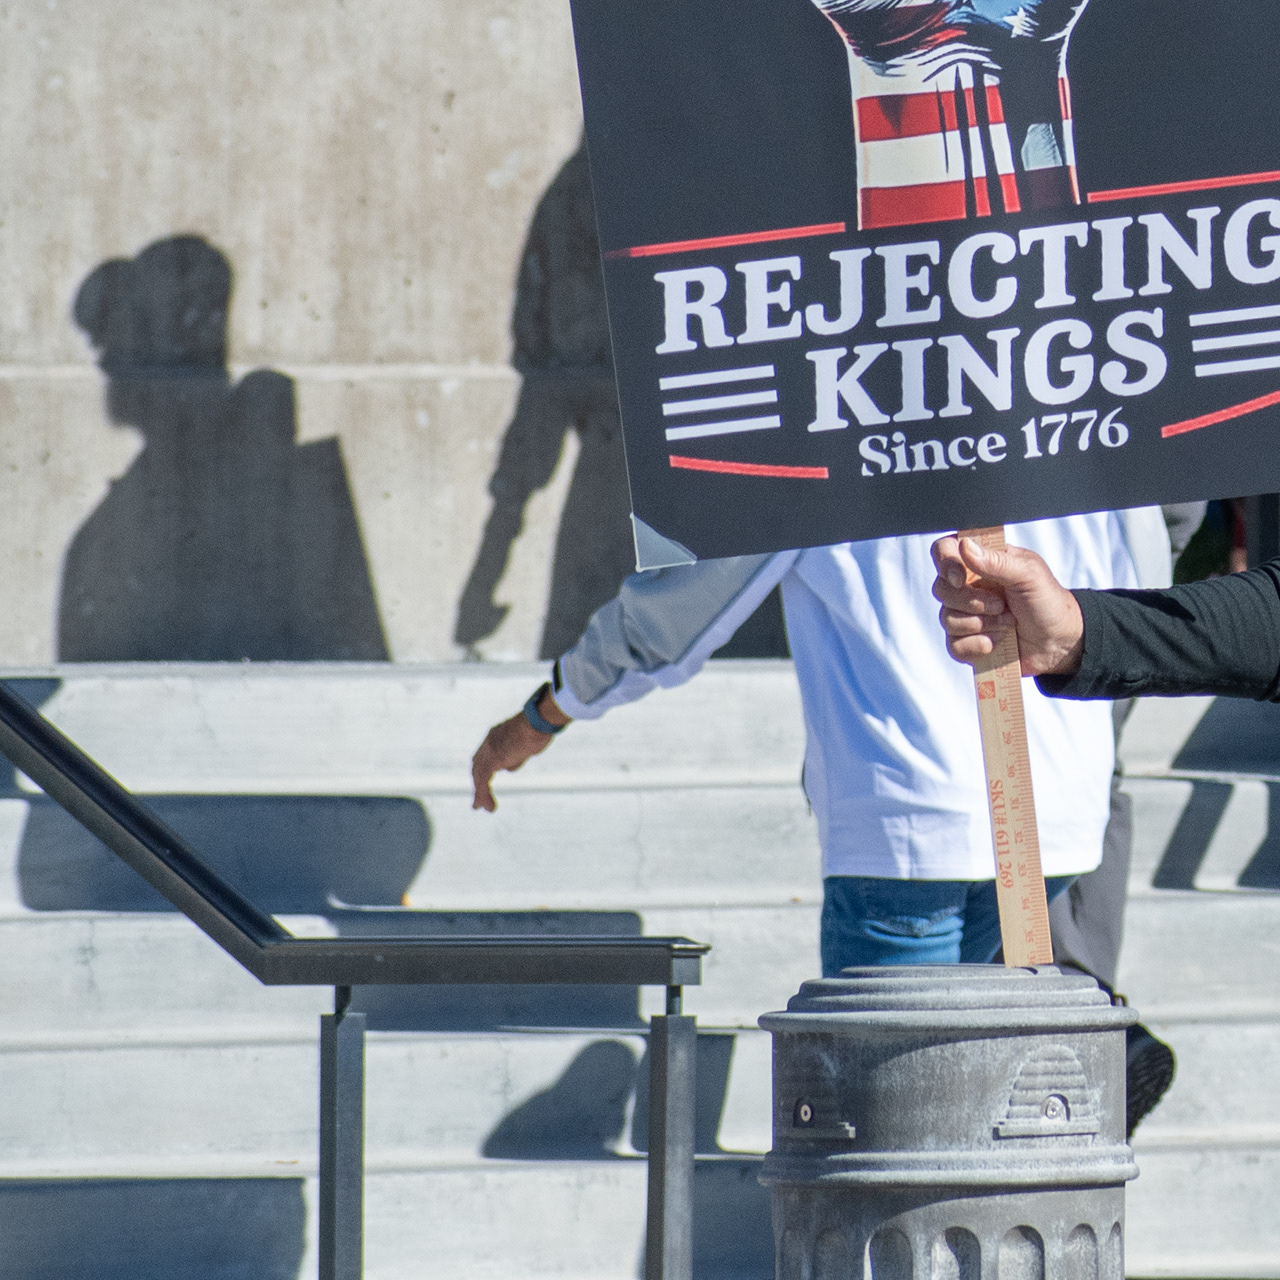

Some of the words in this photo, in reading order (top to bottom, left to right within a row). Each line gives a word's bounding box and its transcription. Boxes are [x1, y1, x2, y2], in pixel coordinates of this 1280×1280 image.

[805, 307, 1169, 434] KINGS
[858, 432, 1008, 478] Since
[1019, 406, 1130, 462] 1776
[989, 779, 1008, 825] SKU#
[995, 830, 1011, 857] 611
[998, 862, 1015, 889] 269
